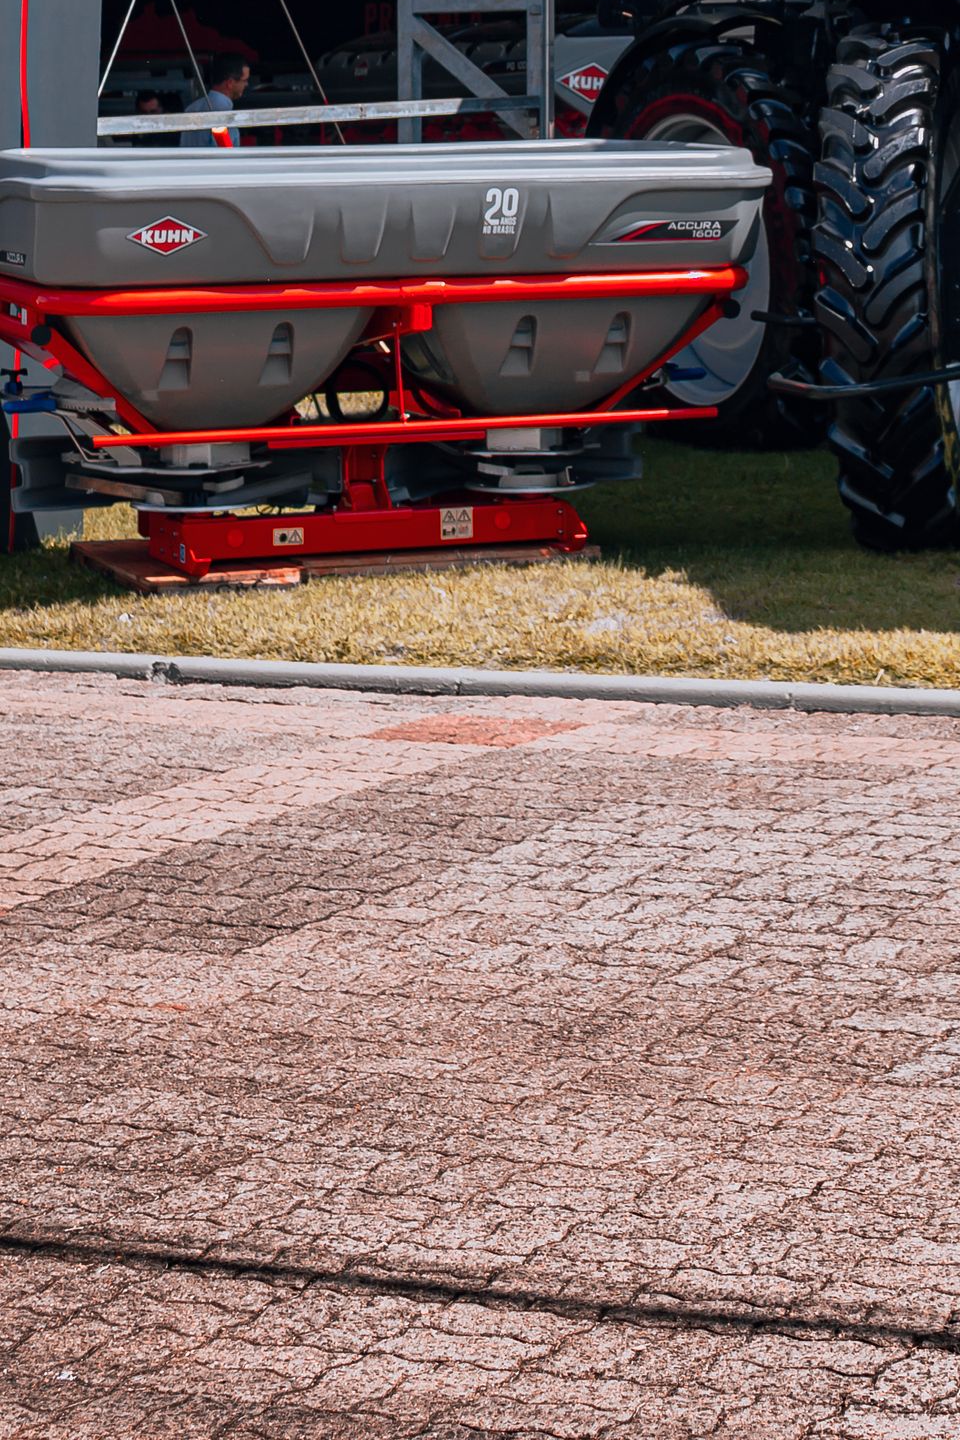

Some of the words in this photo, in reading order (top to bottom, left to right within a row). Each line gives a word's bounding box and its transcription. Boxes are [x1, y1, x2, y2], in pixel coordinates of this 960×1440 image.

[568, 75, 605, 91] KUH
[484, 187, 519, 226] 20
[492, 225, 516, 235] BRASIL
[667, 220, 722, 231] ACCURA
[141, 229, 194, 245] KUHN
[692, 229, 722, 239] 1600
